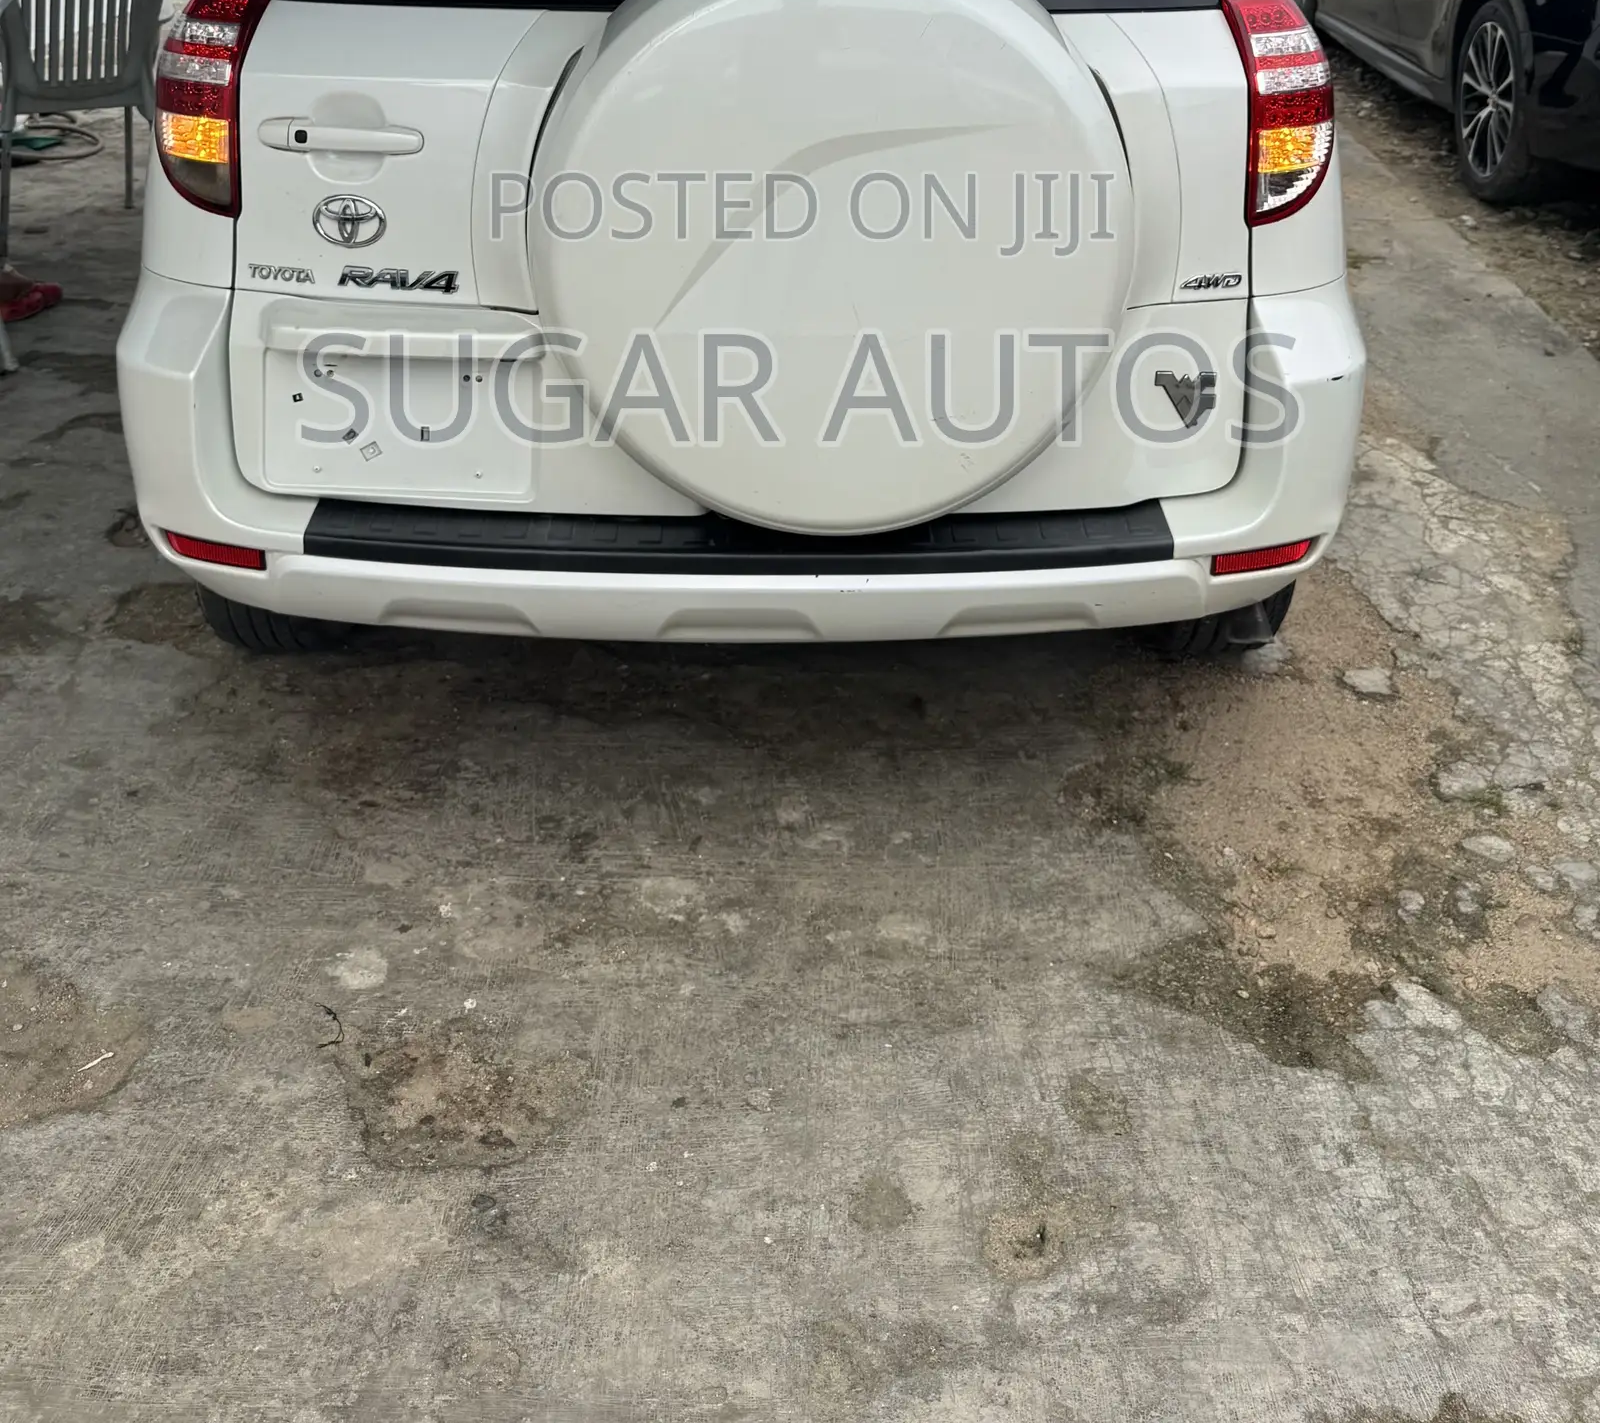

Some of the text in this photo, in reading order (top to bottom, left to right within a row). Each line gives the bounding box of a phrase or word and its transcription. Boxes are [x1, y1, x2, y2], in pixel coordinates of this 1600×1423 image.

[248, 263, 460, 295] TOYOTA RAV4
[1180, 272, 1242, 290] 4WD
